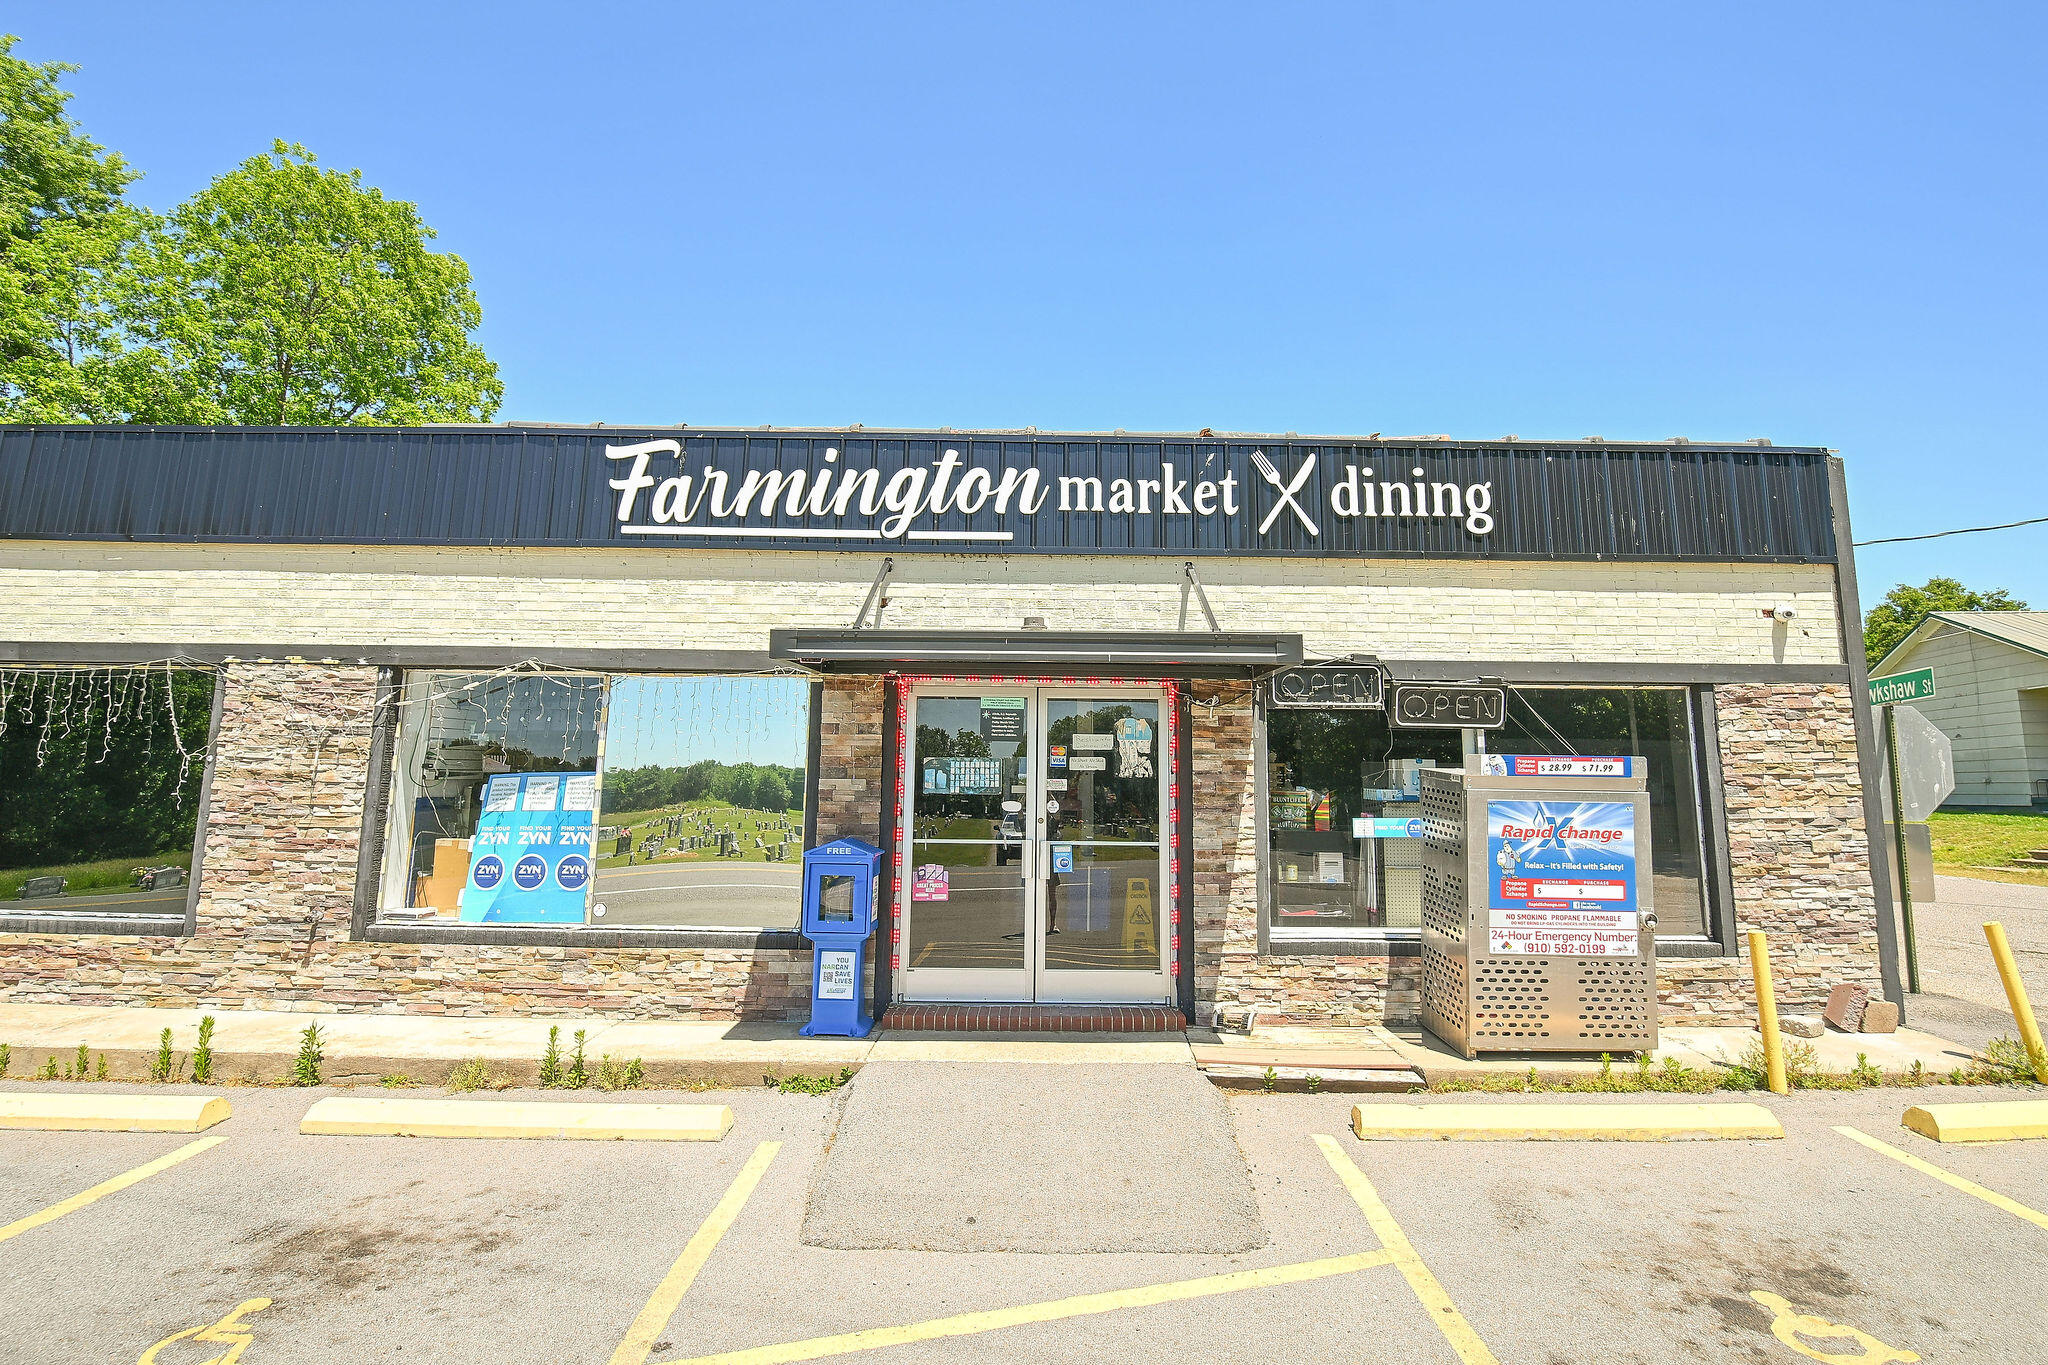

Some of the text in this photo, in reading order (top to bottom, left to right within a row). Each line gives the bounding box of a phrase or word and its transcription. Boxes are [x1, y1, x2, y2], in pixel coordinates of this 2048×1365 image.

[606, 439, 1050, 539] Farmington
[1058, 462, 1239, 516] market
[1331, 465, 1494, 536] dining
[1281, 673, 1374, 700] OPEN
[1922, 679, 1932, 694] St
[1404, 694, 1498, 719] OPEN
[1541, 764, 1546, 772] $
[1549, 764, 1572, 772] 28.99
[1589, 764, 1614, 773] 71.99
[478, 832, 510, 845] ZYN
[517, 832, 552, 845] ZYN
[559, 832, 591, 845] ZYN
[826, 847, 852, 855] FREE
[478, 865, 500, 874] ZYN
[519, 865, 542, 874] ZYN
[561, 865, 585, 874] ZYN
[1524, 862, 1544, 870] Relax
[1562, 862, 1581, 870] Filled
[1599, 863, 1624, 872] Safety!
[1491, 930, 1637, 944] 24-Hour Emergency Number:
[1523, 942, 1551, 954] (910)
[1554, 943, 1606, 954] 592-0199
